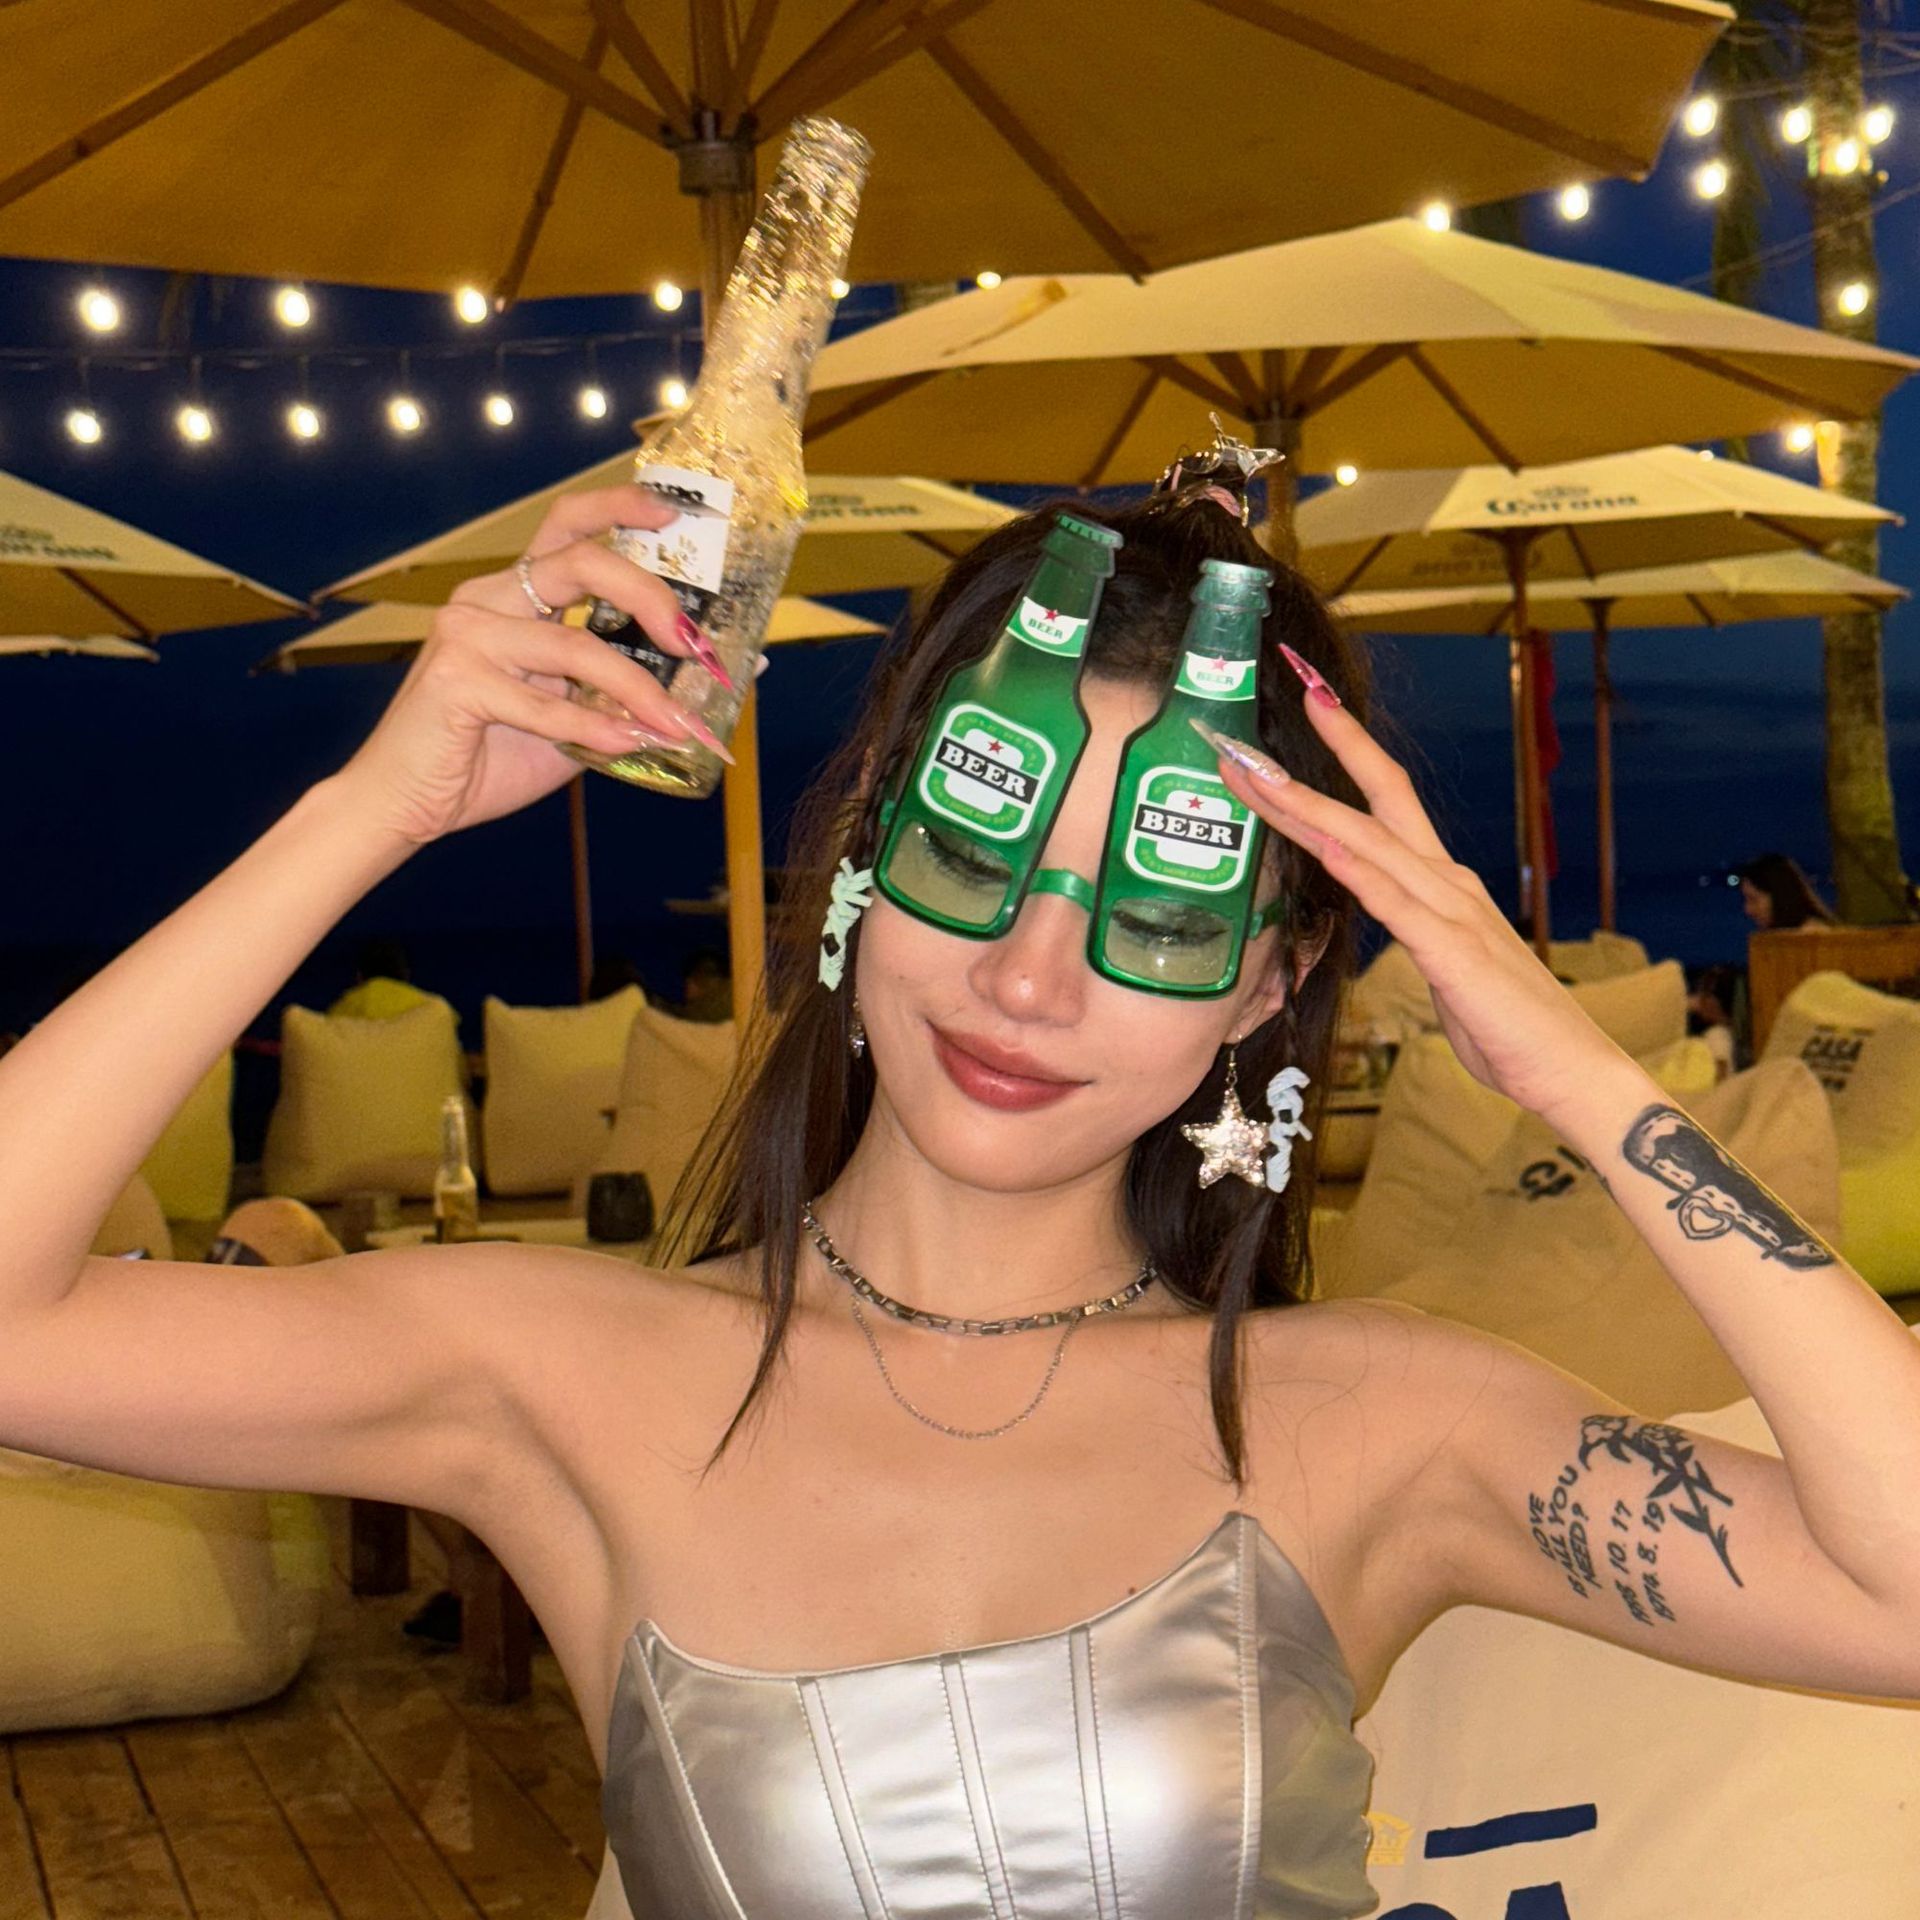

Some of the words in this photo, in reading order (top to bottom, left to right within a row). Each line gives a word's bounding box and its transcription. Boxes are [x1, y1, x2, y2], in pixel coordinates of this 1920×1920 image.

[1028, 618, 1063, 640] BEER
[1196, 670, 1234, 687] BEER
[941, 742, 1025, 798] BEER
[1140, 809, 1234, 846] BEER
[1547, 1464, 1579, 1526] YOU
[1529, 1492, 1557, 1561] LOVE
[1610, 1500, 1632, 1532] 17
[1642, 1501, 1666, 1533] 19
[1550, 1533, 1581, 1579] ALL
[1569, 1502, 1602, 1589] NEED?
[1567, 1574, 1589, 1599] IS
